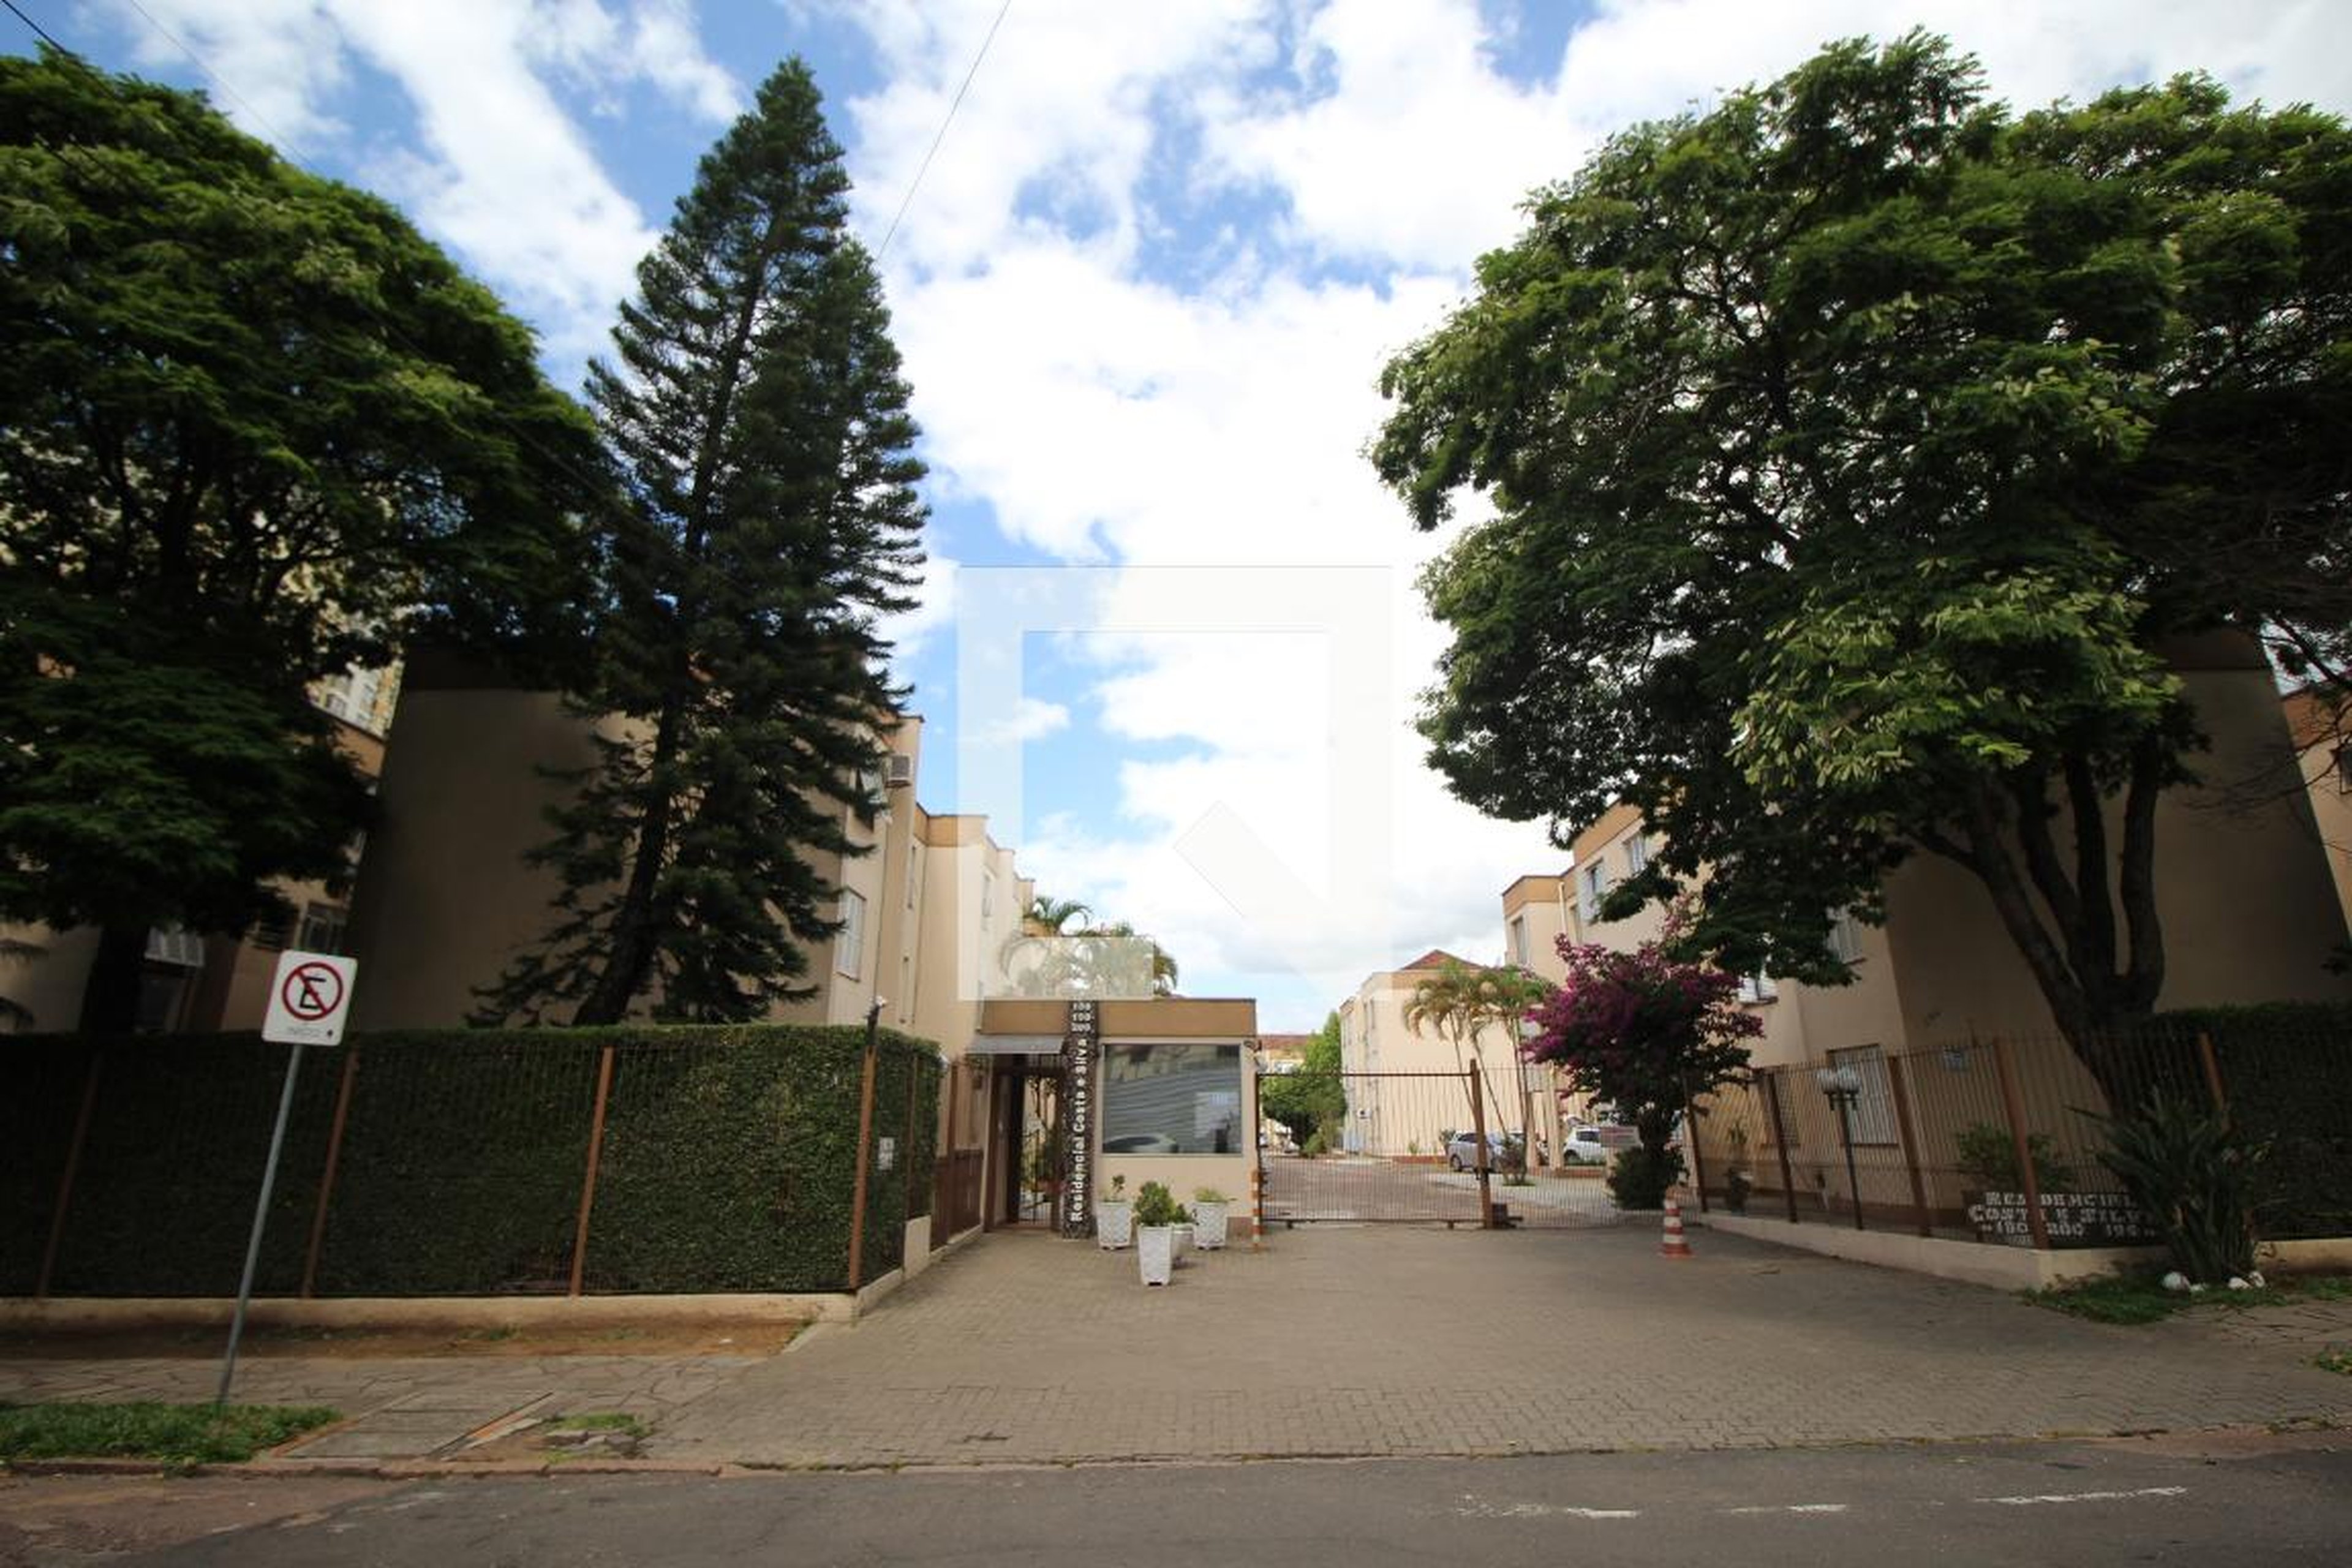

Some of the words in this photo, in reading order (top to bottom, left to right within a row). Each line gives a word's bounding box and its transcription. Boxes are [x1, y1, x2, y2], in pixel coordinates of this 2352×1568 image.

[1075, 1039, 1087, 1074] Silva
[1077, 1078, 1086, 1087] e
[1073, 1091, 1085, 1132] Costa
[1071, 1136, 1085, 1221] Residencial
[1986, 1191, 2136, 1207] RESDENCIAL
